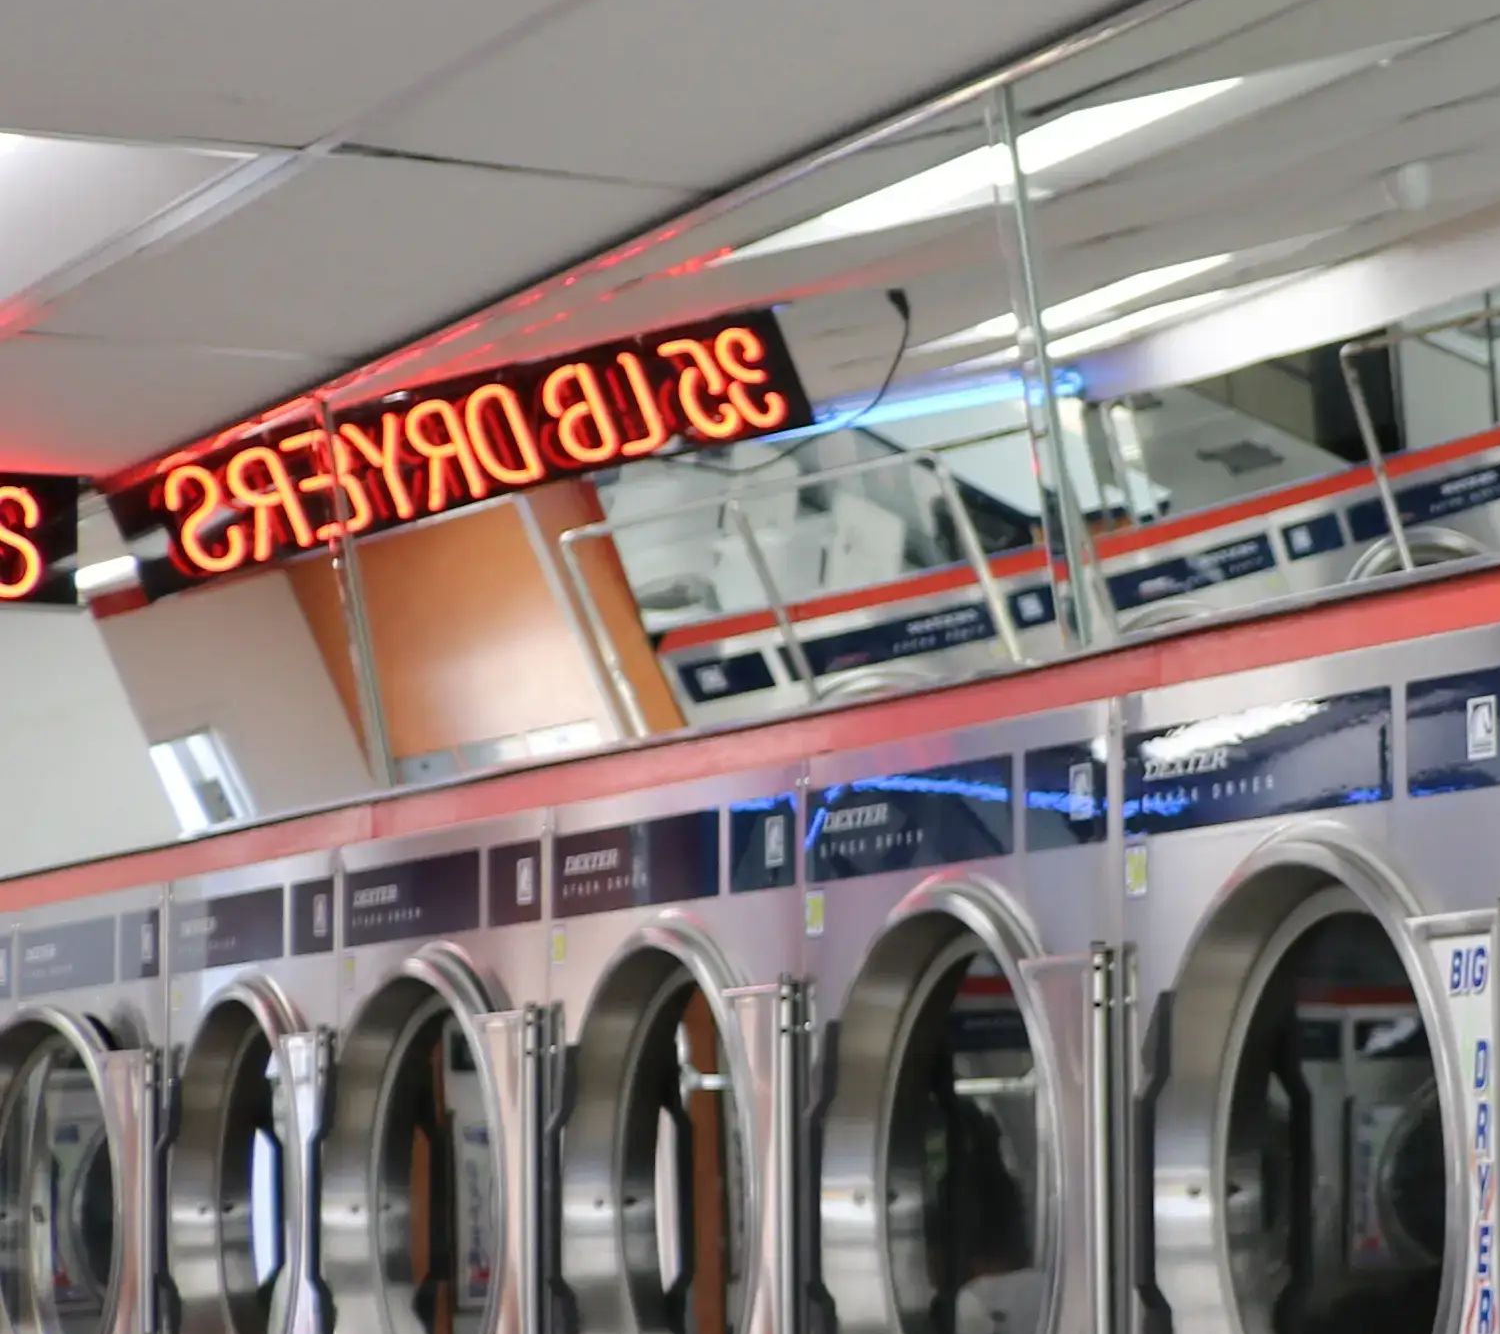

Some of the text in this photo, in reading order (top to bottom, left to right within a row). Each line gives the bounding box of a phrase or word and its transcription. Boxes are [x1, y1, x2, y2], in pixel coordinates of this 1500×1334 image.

[1142, 746, 1228, 781] DEXTER
[1211, 775, 1278, 803] DRYER
[821, 802, 890, 834] DEXTER
[1450, 945, 1489, 992] BIG
